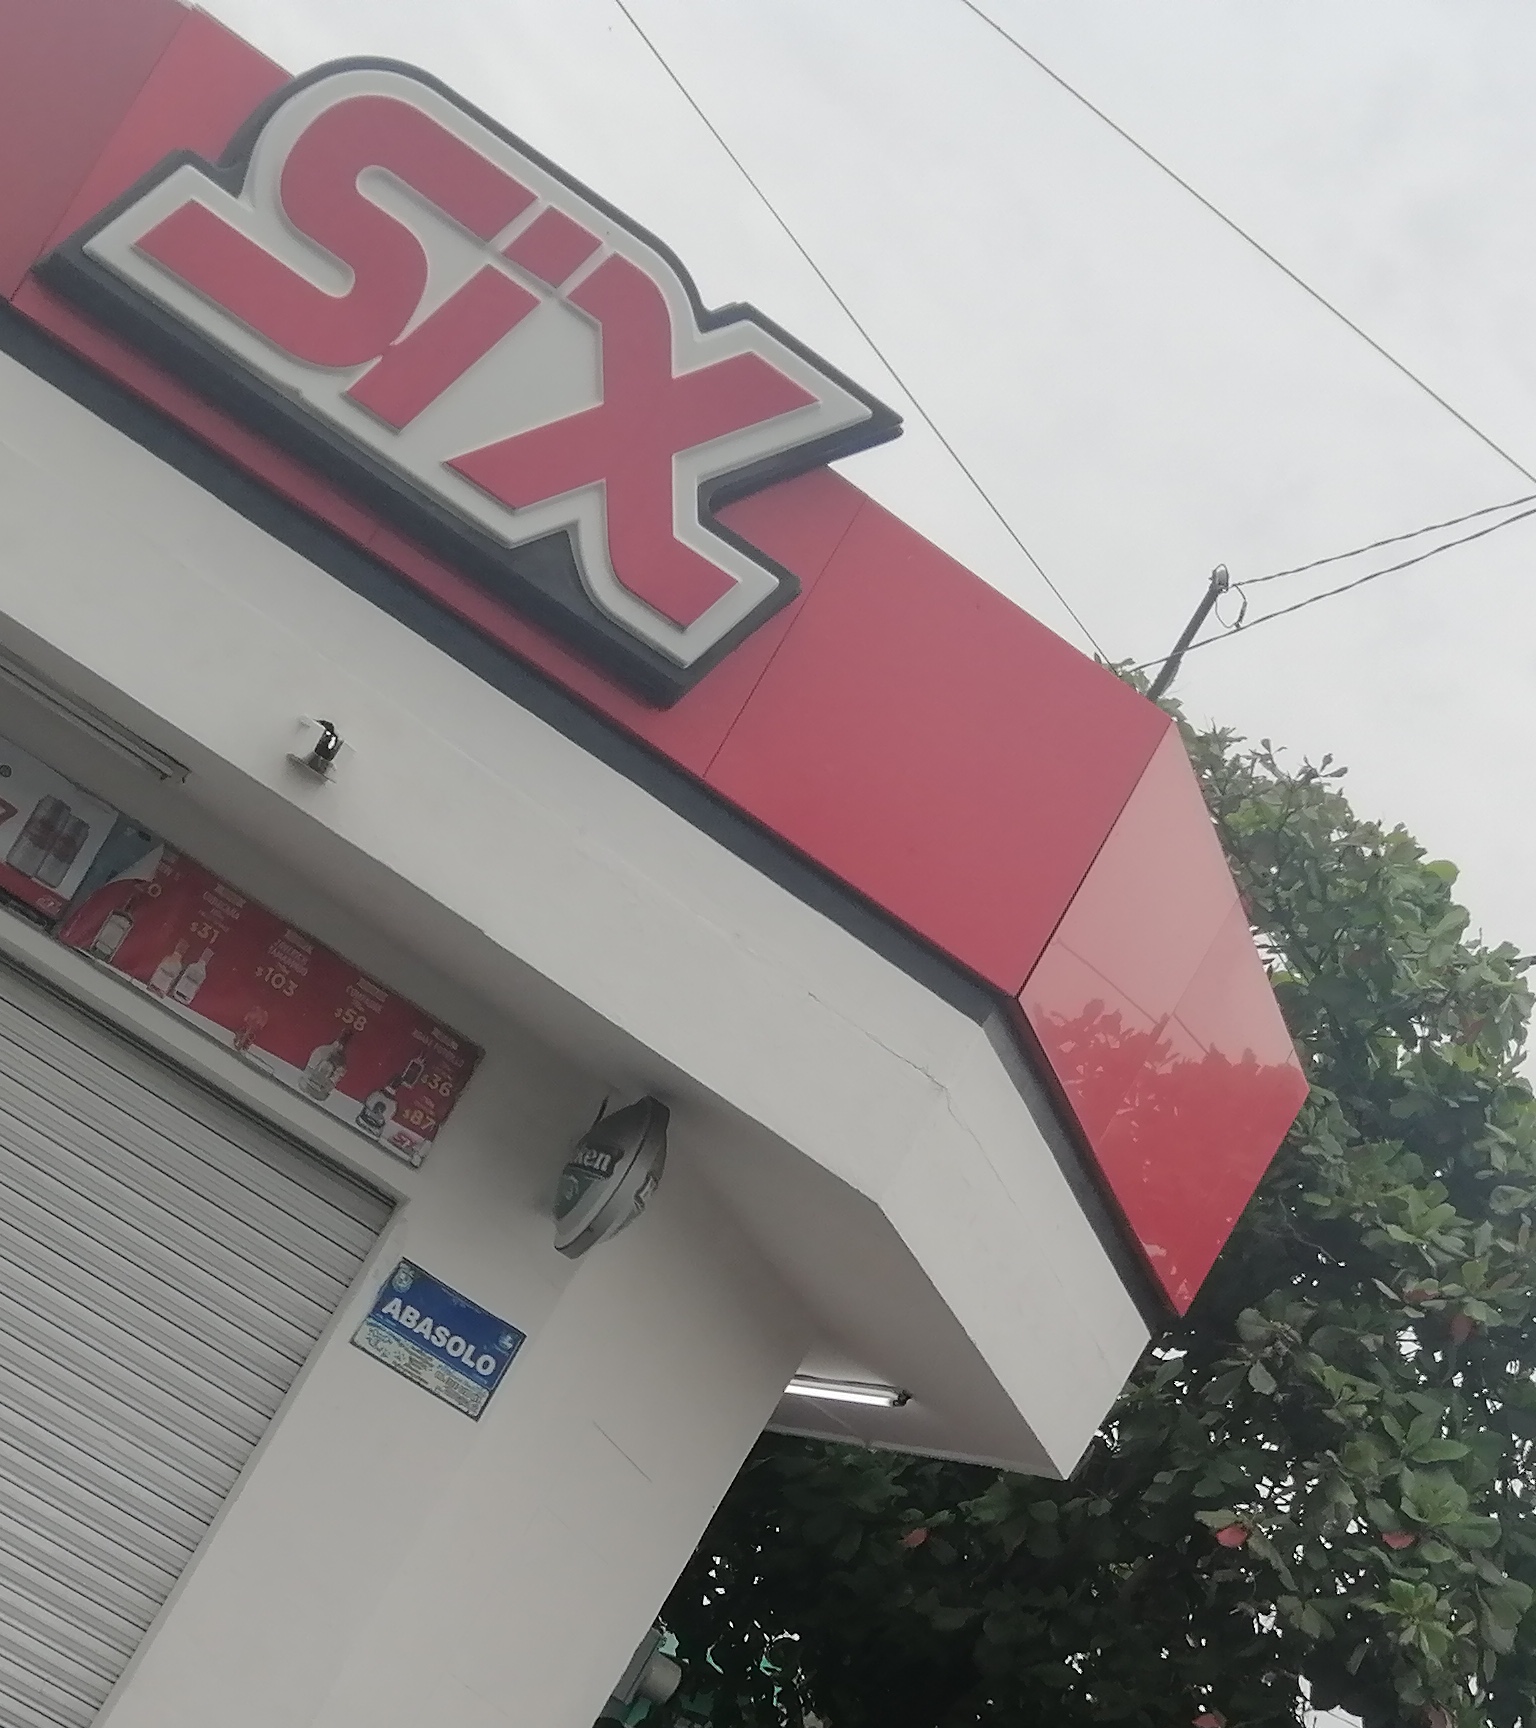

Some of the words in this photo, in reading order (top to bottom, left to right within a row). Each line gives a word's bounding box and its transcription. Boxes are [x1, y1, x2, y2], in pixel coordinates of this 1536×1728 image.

[255, 965, 299, 997] $103
[334, 1007, 368, 1032] $58
[382, 1297, 497, 1376] ABASOLO
